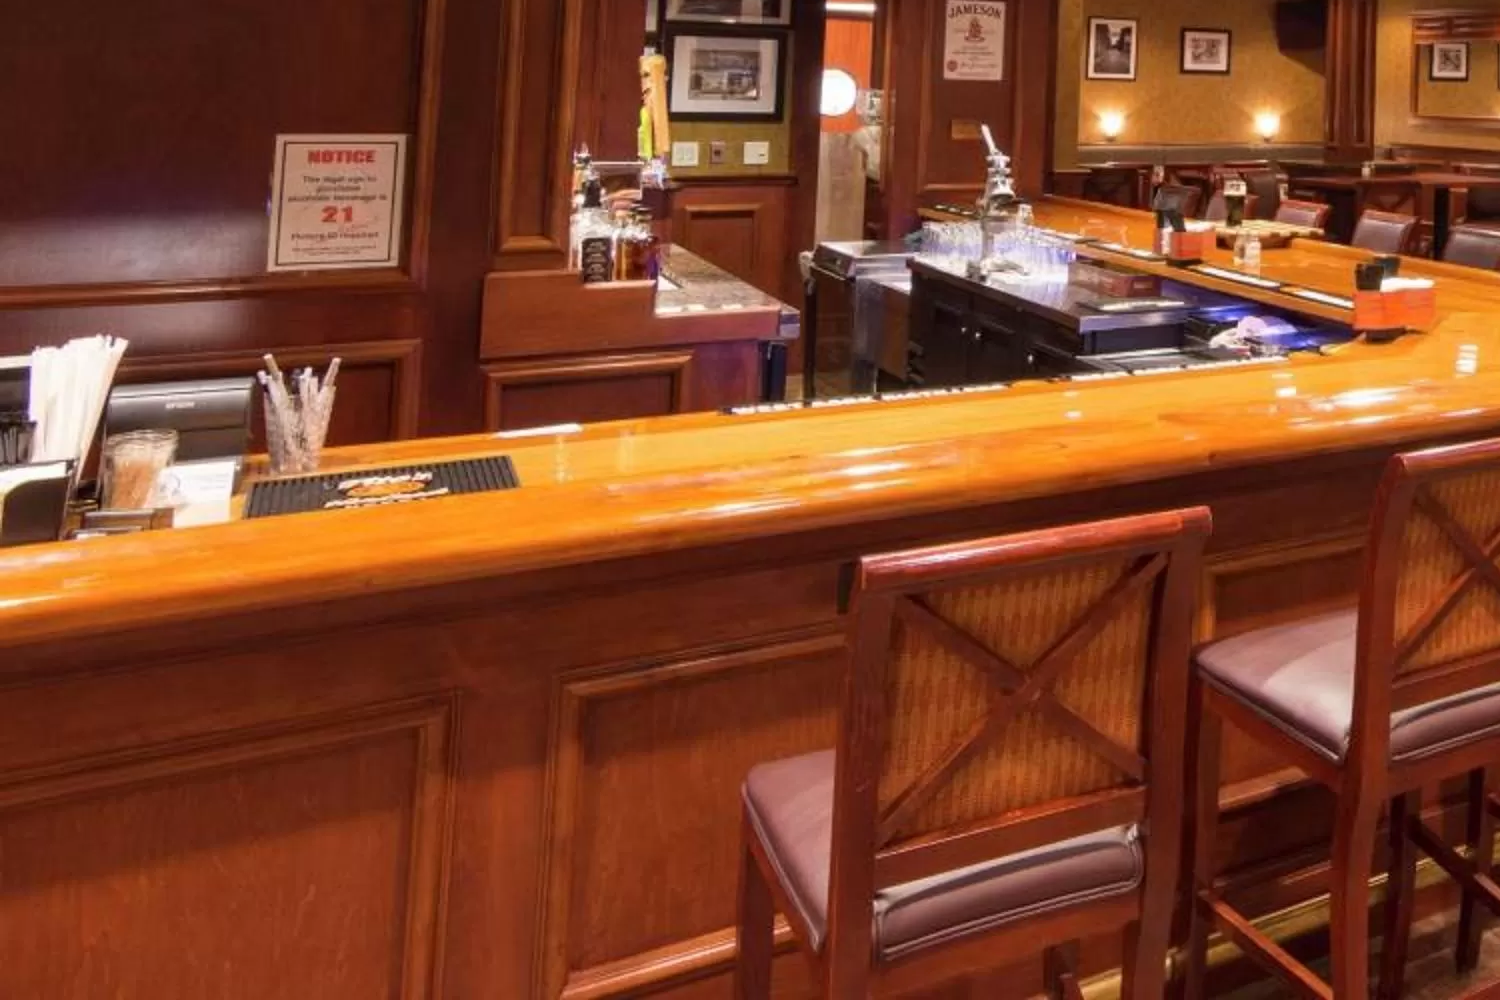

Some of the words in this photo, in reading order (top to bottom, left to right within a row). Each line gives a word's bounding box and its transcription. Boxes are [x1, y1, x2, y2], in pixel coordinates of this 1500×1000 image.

[947, 3, 1002, 20] JAMESON
[307, 150, 376, 164] NOTICE
[321, 206, 353, 223] 21
